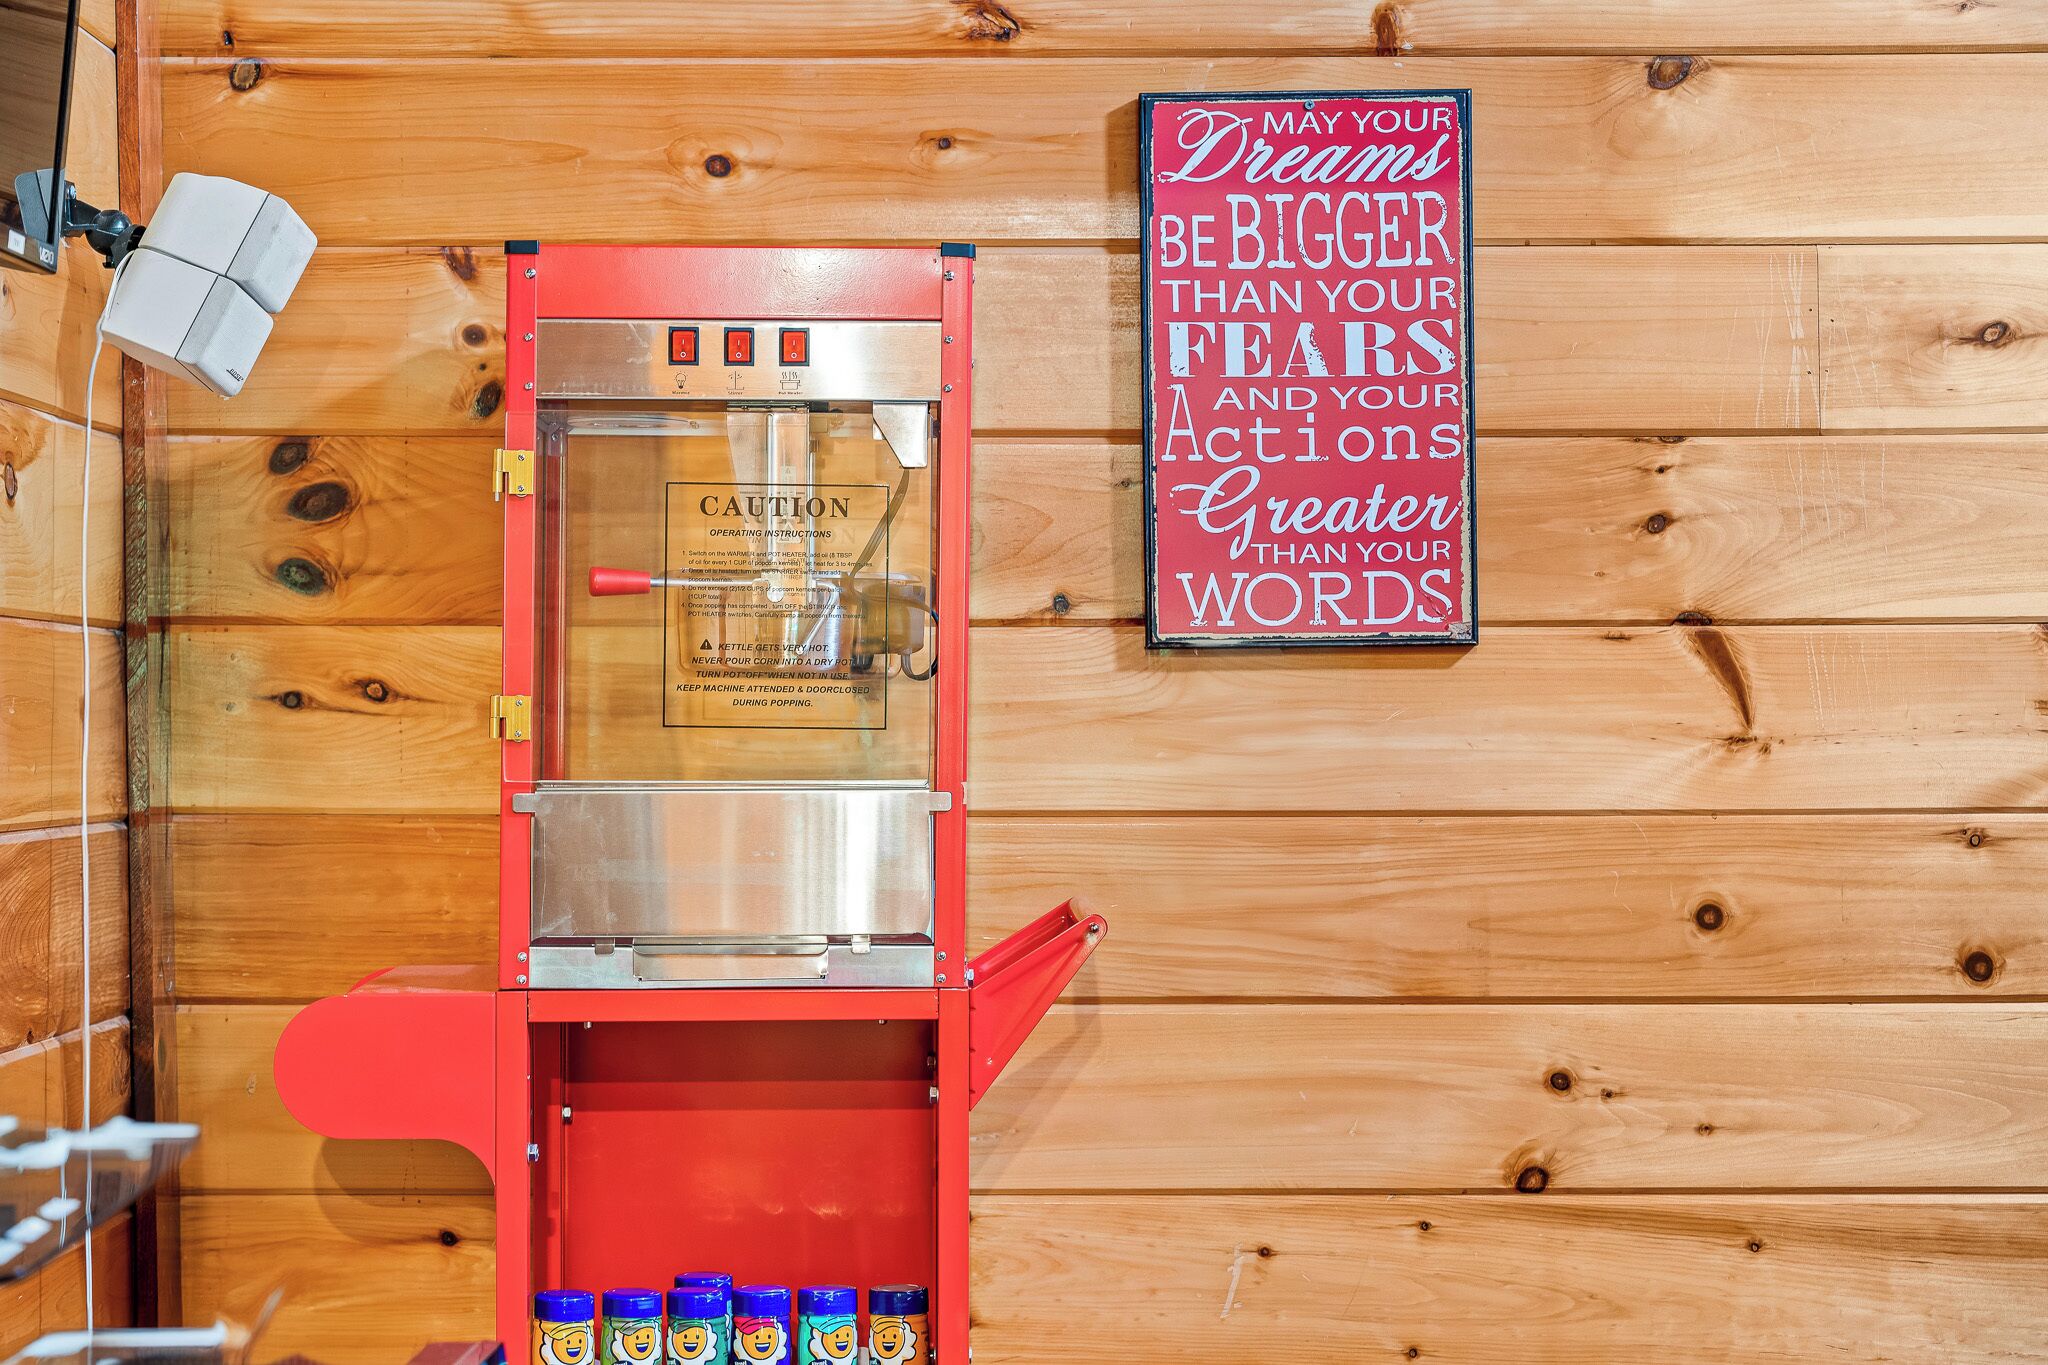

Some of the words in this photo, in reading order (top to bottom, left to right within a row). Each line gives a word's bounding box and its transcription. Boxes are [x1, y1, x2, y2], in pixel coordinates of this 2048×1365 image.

[1263, 110, 1341, 135] MAY
[1351, 107, 1452, 134] YOUR
[1158, 108, 1451, 184] Dreams
[1159, 214, 1217, 268] BE
[1225, 190, 1456, 270] BIGGER
[1160, 279, 1302, 313] THAN
[1316, 276, 1457, 313] YOUR
[1164, 318, 1457, 378] FEARS
[1212, 387, 1318, 411] AND
[1329, 384, 1460, 411] YOUR
[1161, 383, 1462, 463] Actions
[700, 495, 850, 518] CAUTION
[1169, 465, 1463, 560] Greater
[710, 529, 762, 537] OPERATING
[764, 529, 832, 538] INSTRUCTIONS
[1250, 542, 1347, 564] THAN
[1355, 541, 1451, 563] YOUR
[1175, 568, 1452, 627] WORDS
[692, 656, 723, 664] NEVER
[718, 643, 754, 651] KETTLE
[732, 698, 768, 706] DURING
